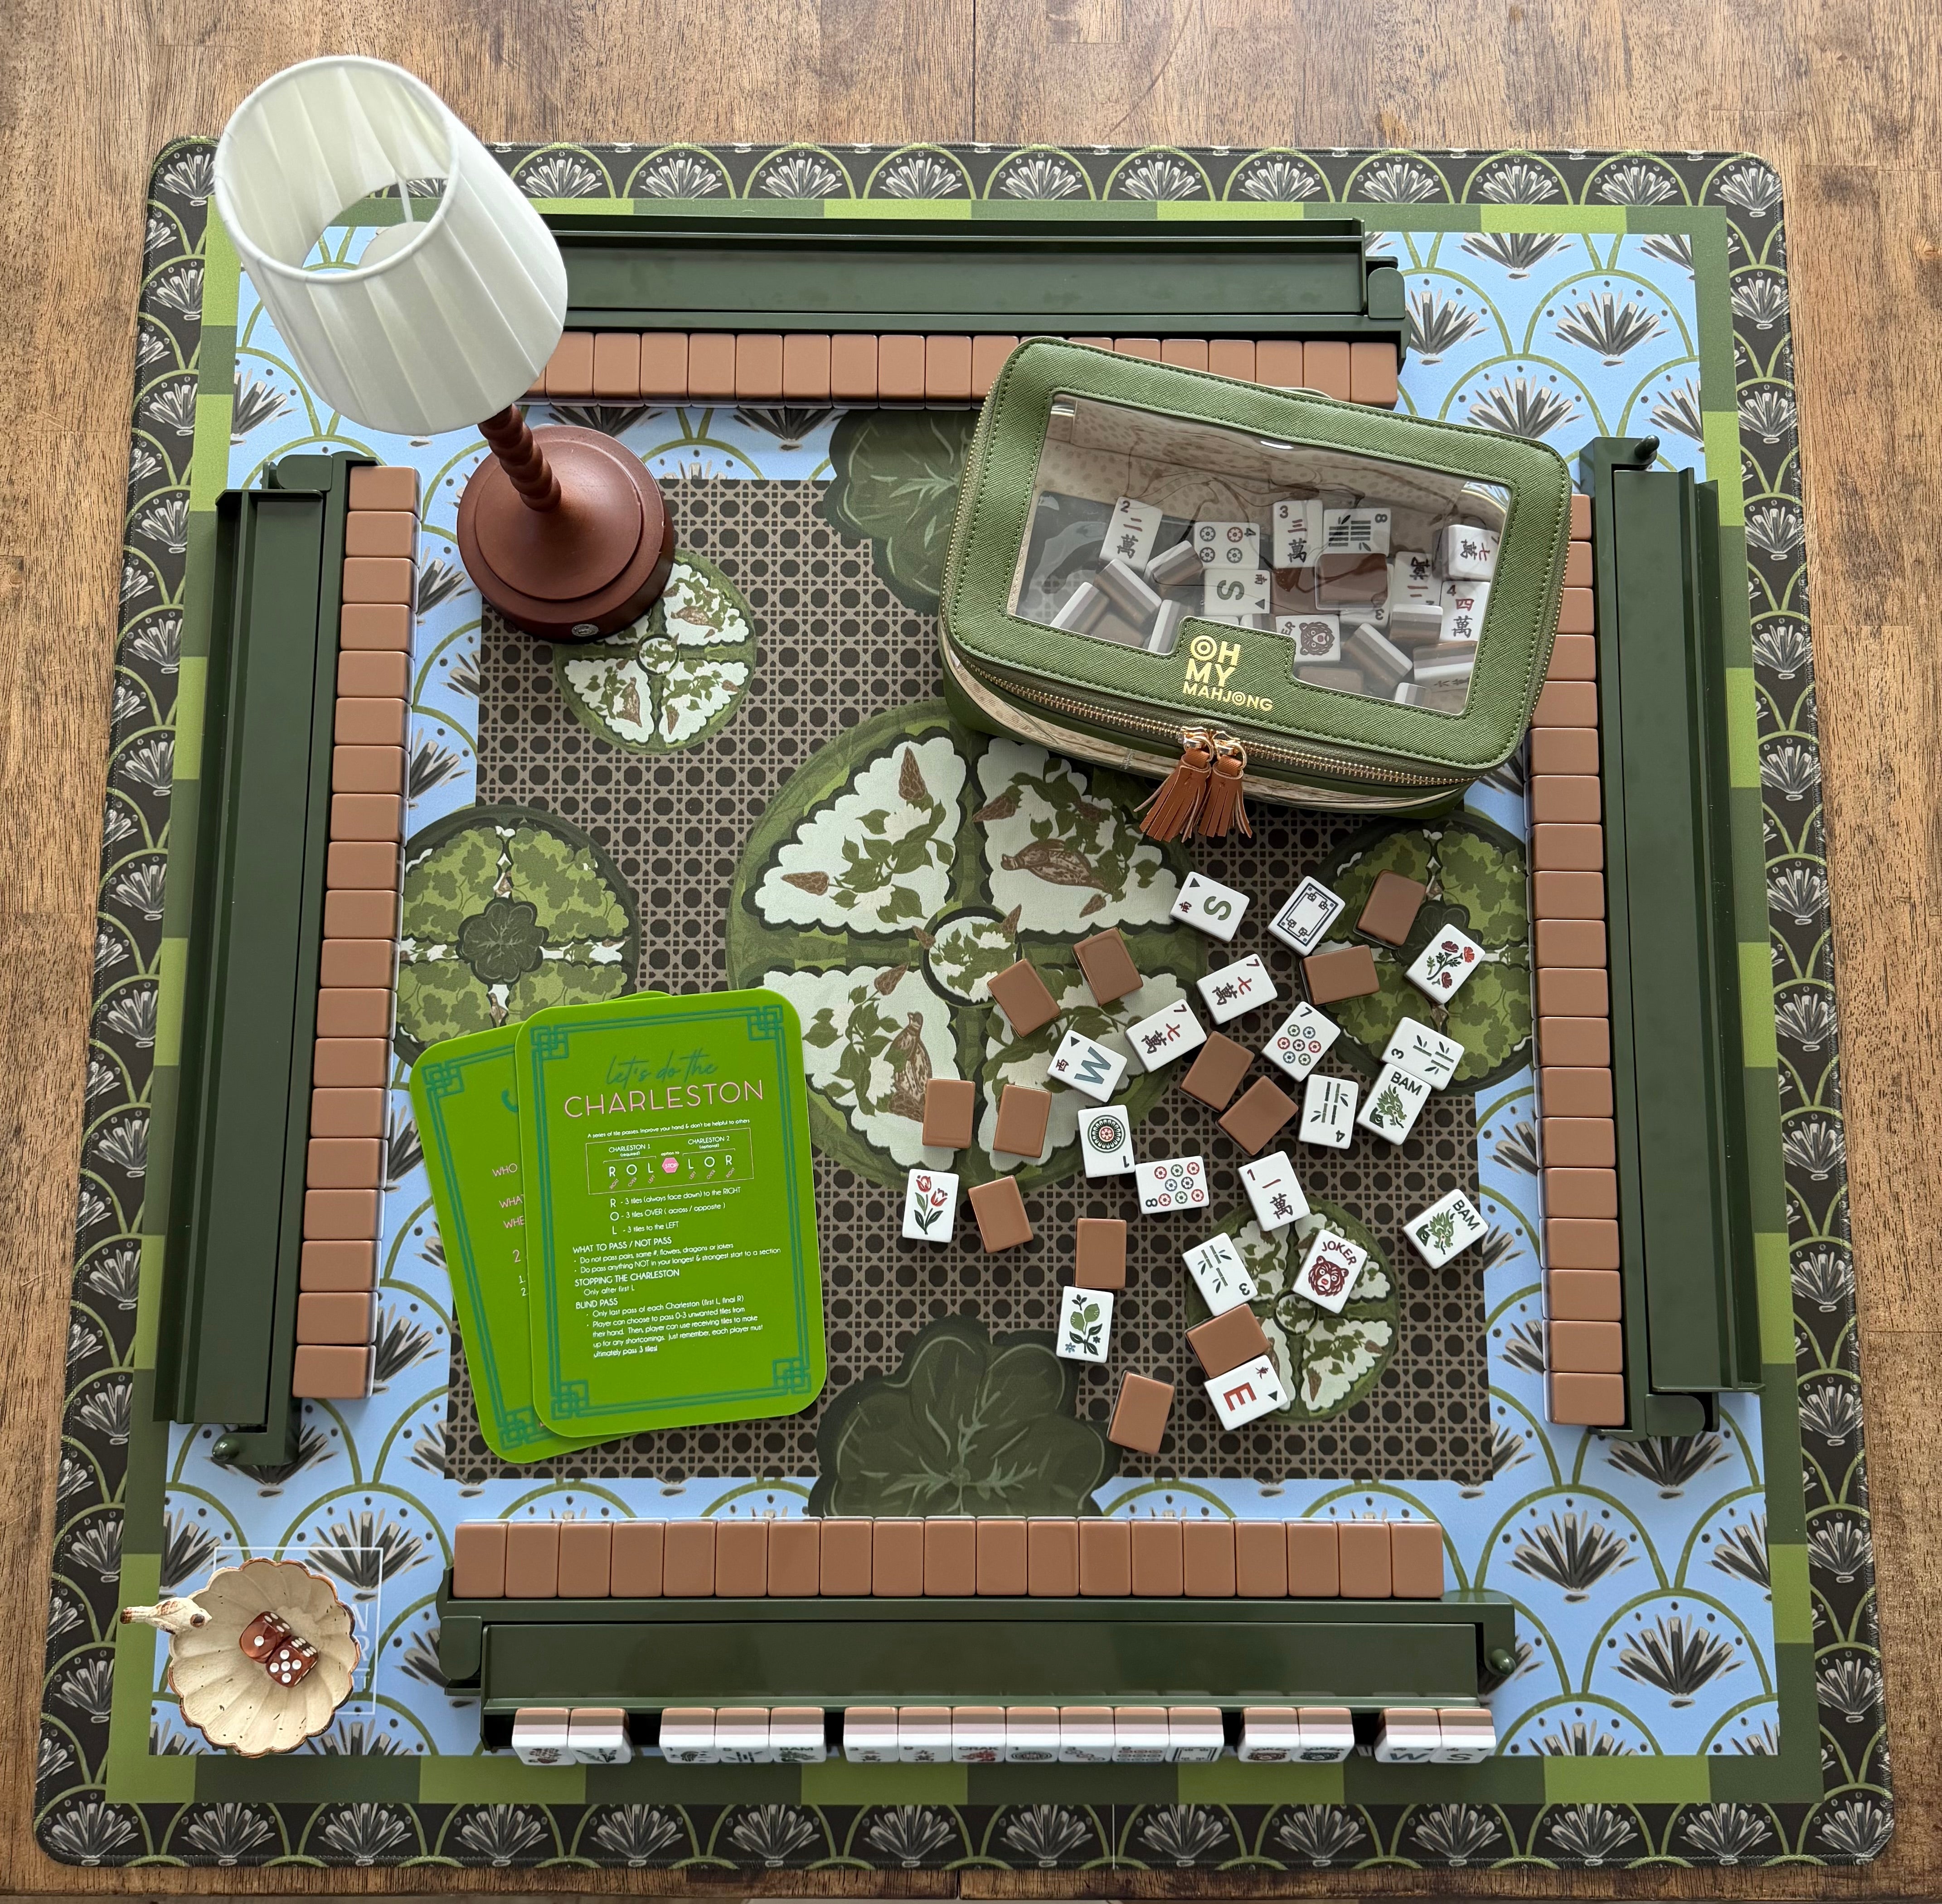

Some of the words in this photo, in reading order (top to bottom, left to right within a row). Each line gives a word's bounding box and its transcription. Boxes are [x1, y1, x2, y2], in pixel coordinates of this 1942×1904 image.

[1120, 500, 1131, 513] 2
[1279, 505, 1289, 519] 3
[1374, 513, 1388, 523] 8
[1244, 528, 1257, 538] 4
[1254, 574, 1267, 586] 南
[1217, 579, 1245, 601] S
[1447, 584, 1456, 596] 4
[1190, 635, 1241, 666] OH
[1185, 658, 1236, 687] MY
[1182, 681, 1273, 712] MAHJONG
[1203, 896, 1232, 921] S
[1246, 958, 1260, 967] 7
[1173, 1004, 1187, 1013] 7
[1299, 1006, 1313, 1017] 7
[1391, 1047, 1405, 1060] 3
[606, 1055, 651, 1090] let's
[655, 1051, 681, 1082] do
[680, 1049, 719, 1083] the
[1073, 1046, 1112, 1085] W
[1390, 1071, 1423, 1096] BAM
[564, 1079, 763, 1118] CHARLESTON
[688, 1135, 725, 1145] CHARLESTON
[1335, 1129, 1345, 1143] 4
[608, 1144, 646, 1153] CHARLESTON
[688, 1158, 694, 1169] L
[704, 1156, 715, 1168] O
[725, 1155, 733, 1165] R
[1122, 1155, 1130, 1168] 1
[492, 1163, 518, 1177] WHO
[609, 1166, 616, 1177] R
[626, 1164, 637, 1175] O
[647, 1163, 654, 1173] L
[1247, 1168, 1256, 1181] 1
[611, 1199, 616, 1207] R
[1145, 1197, 1158, 1208] 8
[610, 1212, 619, 1221] O
[1452, 1199, 1481, 1231] BAM
[612, 1226, 617, 1235] L
[573, 1245, 593, 1253] WHAT
[609, 1241, 627, 1250] PASS
[635, 1239, 651, 1247] NOT
[654, 1237, 671, 1245] PASS
[512, 1249, 521, 1263] 2
[1322, 1240, 1357, 1266] JOKER
[575, 1276, 612, 1287] STOPPING
[615, 1274, 627, 1283] THE
[630, 1269, 680, 1281] CHARLESTON
[1239, 1282, 1251, 1296] 3
[576, 1300, 597, 1309] BLIND
[600, 1298, 618, 1306] PASS
[688, 1308, 718, 1318] unwanted
[1256, 1365, 1269, 1380] 東
[1223, 1381, 1257, 1412] E
